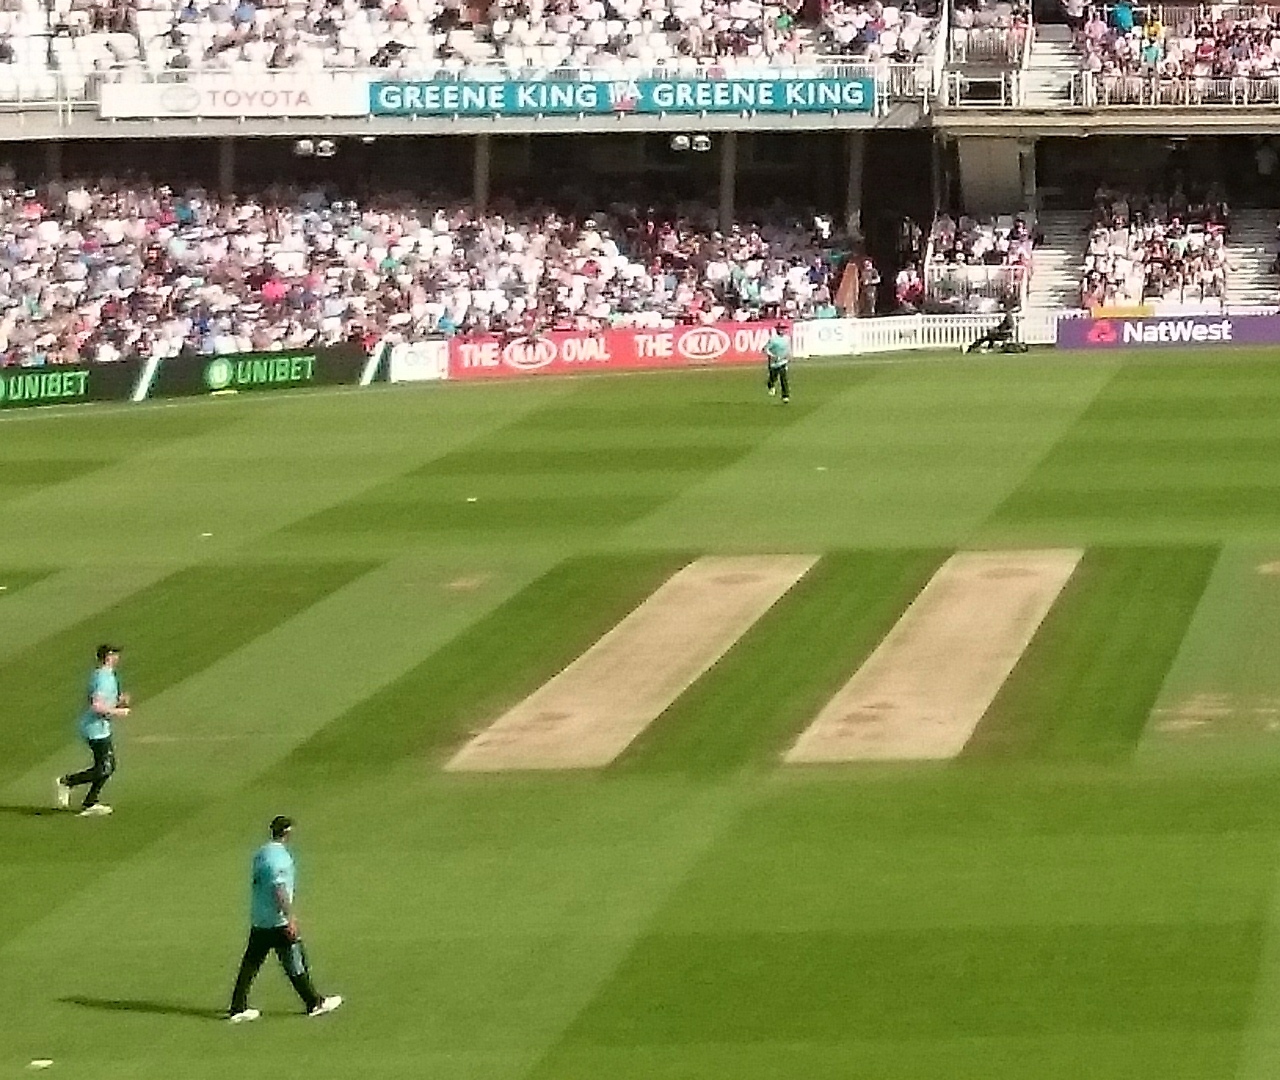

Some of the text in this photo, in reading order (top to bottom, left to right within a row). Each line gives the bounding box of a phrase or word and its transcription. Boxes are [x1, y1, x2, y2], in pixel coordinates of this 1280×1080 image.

[207, 90, 312, 107] TOYOTA
[379, 85, 506, 109] GREENE
[517, 84, 597, 108] KING
[653, 82, 864, 106] GREENE KING
[634, 334, 673, 357] THE
[735, 329, 779, 352] OVA
[1124, 320, 1232, 342] NatWest
[460, 343, 499, 367] THE
[562, 338, 610, 361] OVAL
[237, 356, 316, 383] UNIBET
[9, 371, 89, 399] UNIBET
